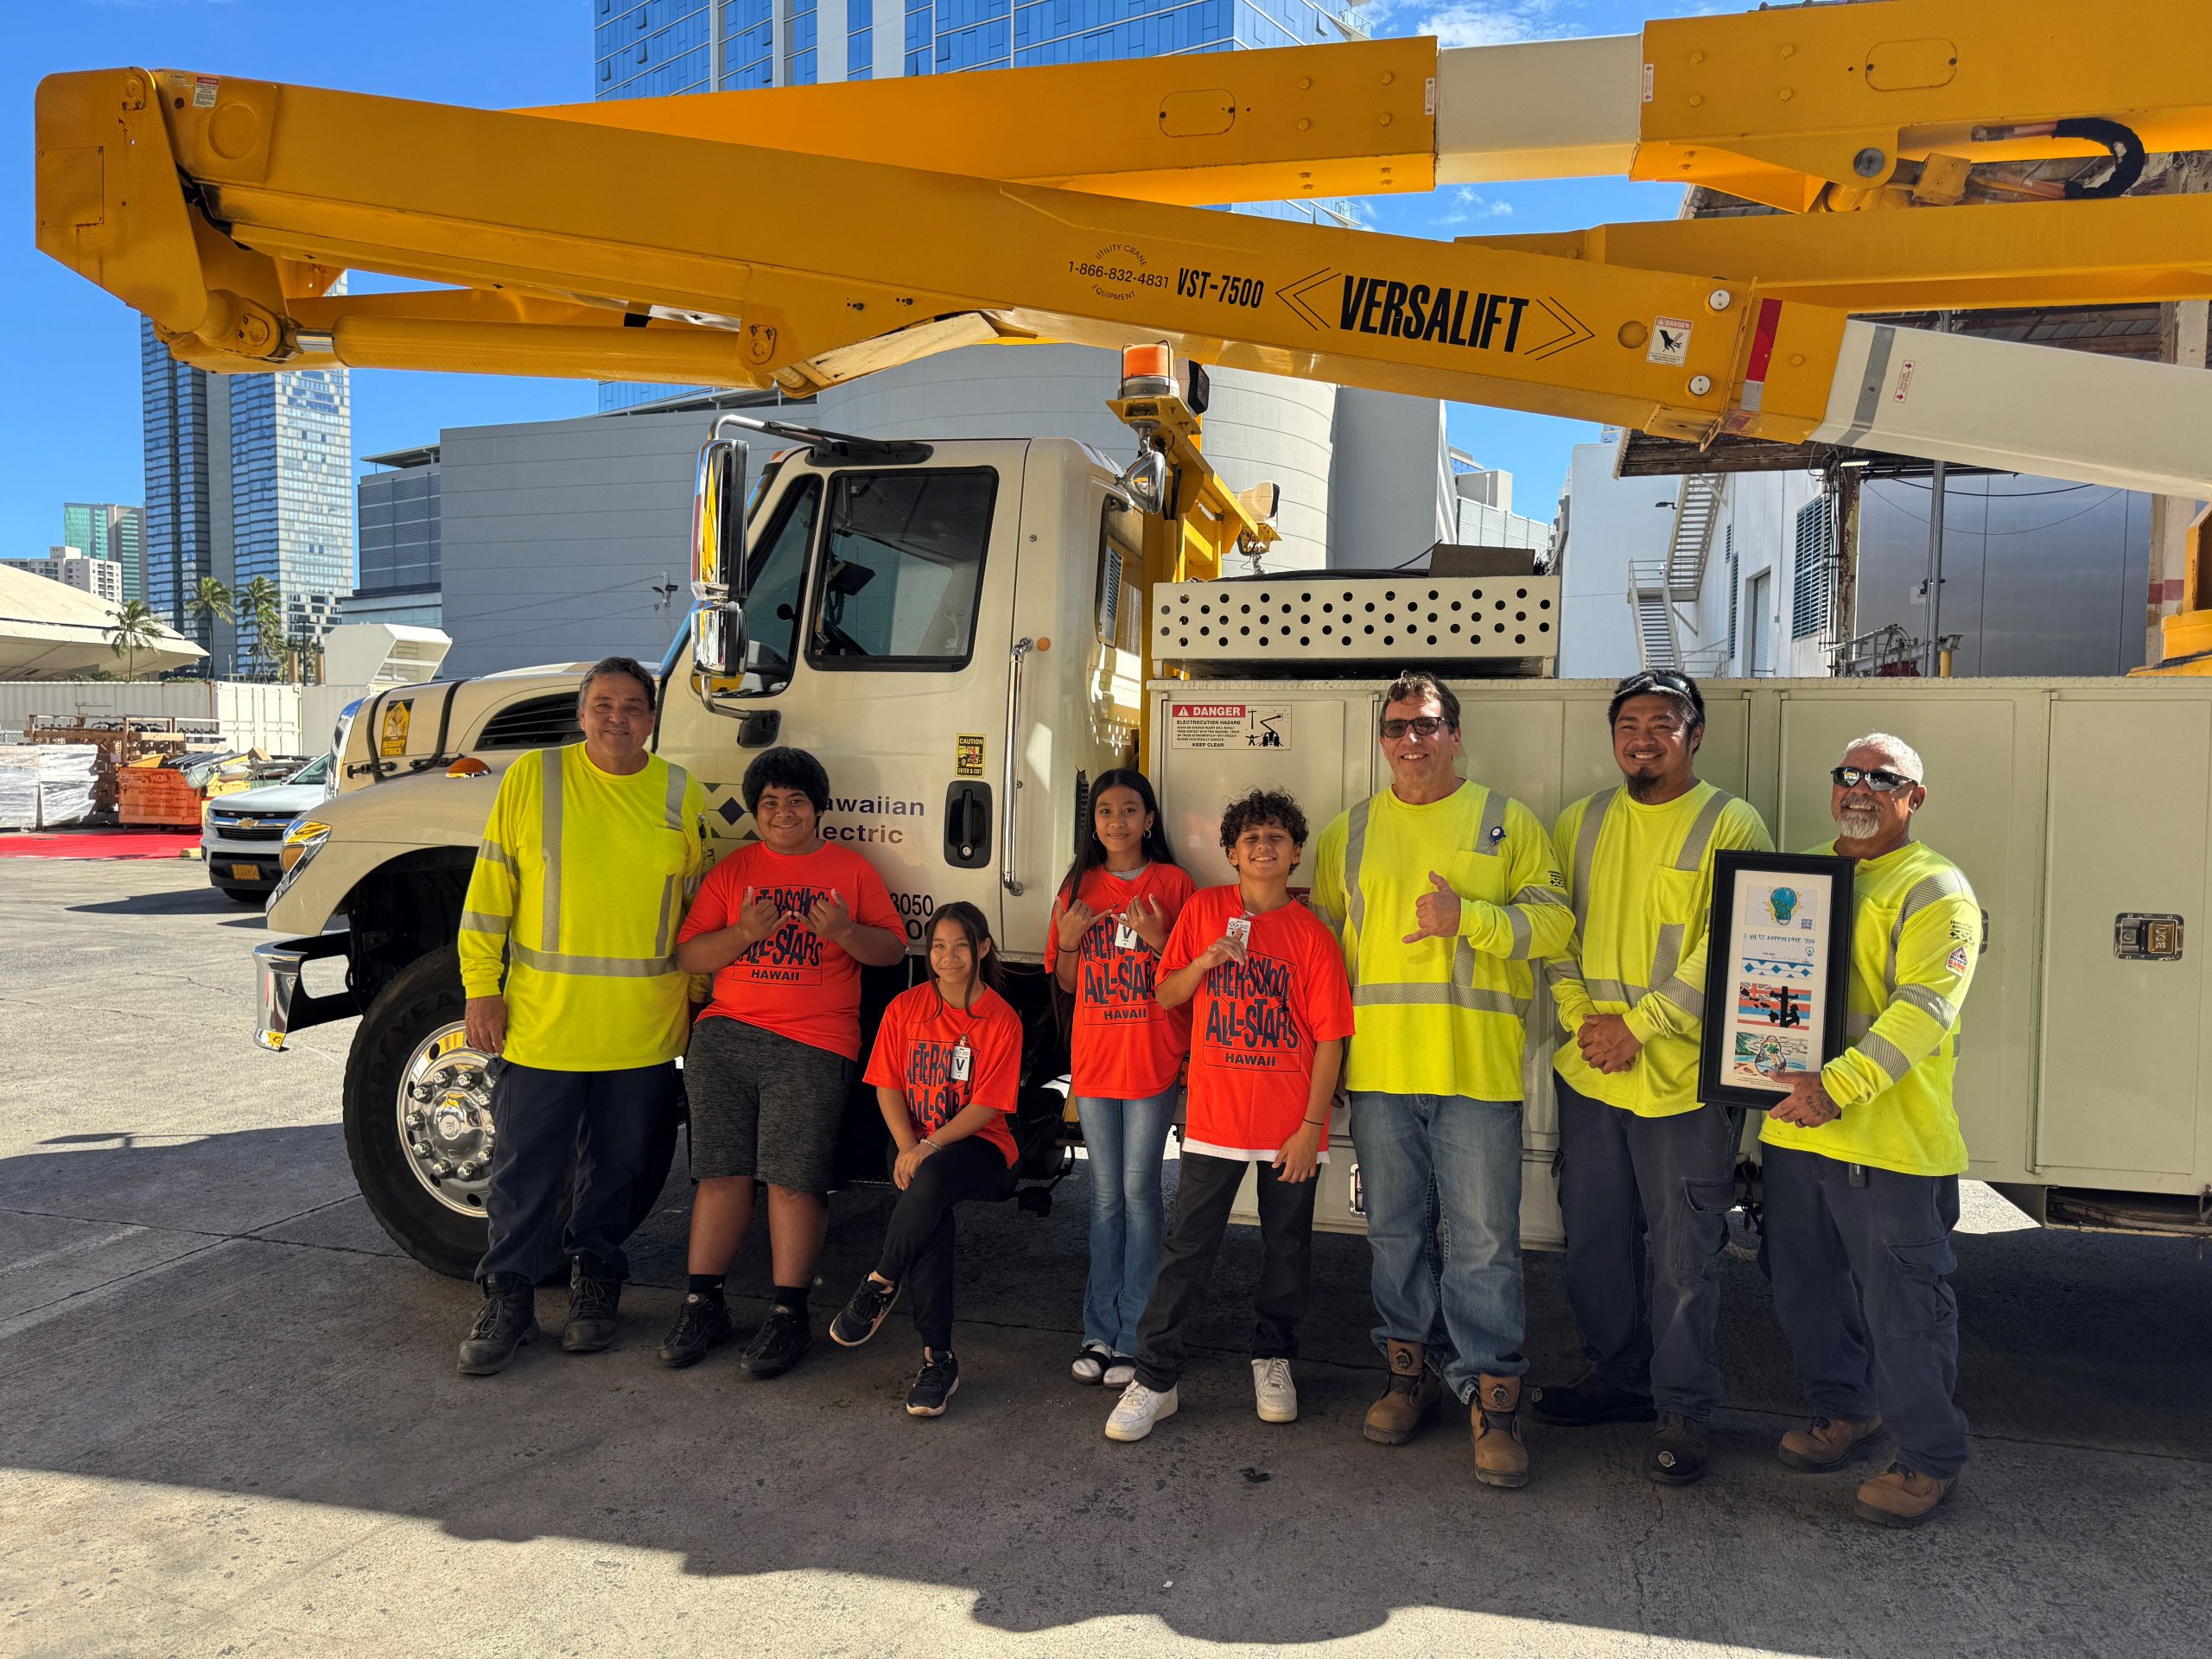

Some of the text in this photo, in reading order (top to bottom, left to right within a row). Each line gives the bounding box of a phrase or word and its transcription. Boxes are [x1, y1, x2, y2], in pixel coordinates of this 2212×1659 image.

[1095, 244, 1147, 267] UTILITY CRANE
[1069, 261, 1169, 289] 1-866-832-4831
[1092, 283, 1136, 301] EQUIPMENT
[1177, 267, 1264, 308] VST-7500
[1340, 275, 1530, 353] VERSALIFT
[1665, 320, 1690, 328] DANGER
[1192, 707, 1241, 716] DANGER
[815, 823, 904, 844] lectric
[1122, 925, 1133, 939] V
[751, 969, 800, 982] HAWAII
[1103, 1008, 1147, 1020] HAWAII
[1205, 998, 1299, 1049] ALL-STARS
[956, 1058, 966, 1071] V
[1225, 1052, 1276, 1066] HAWAII
